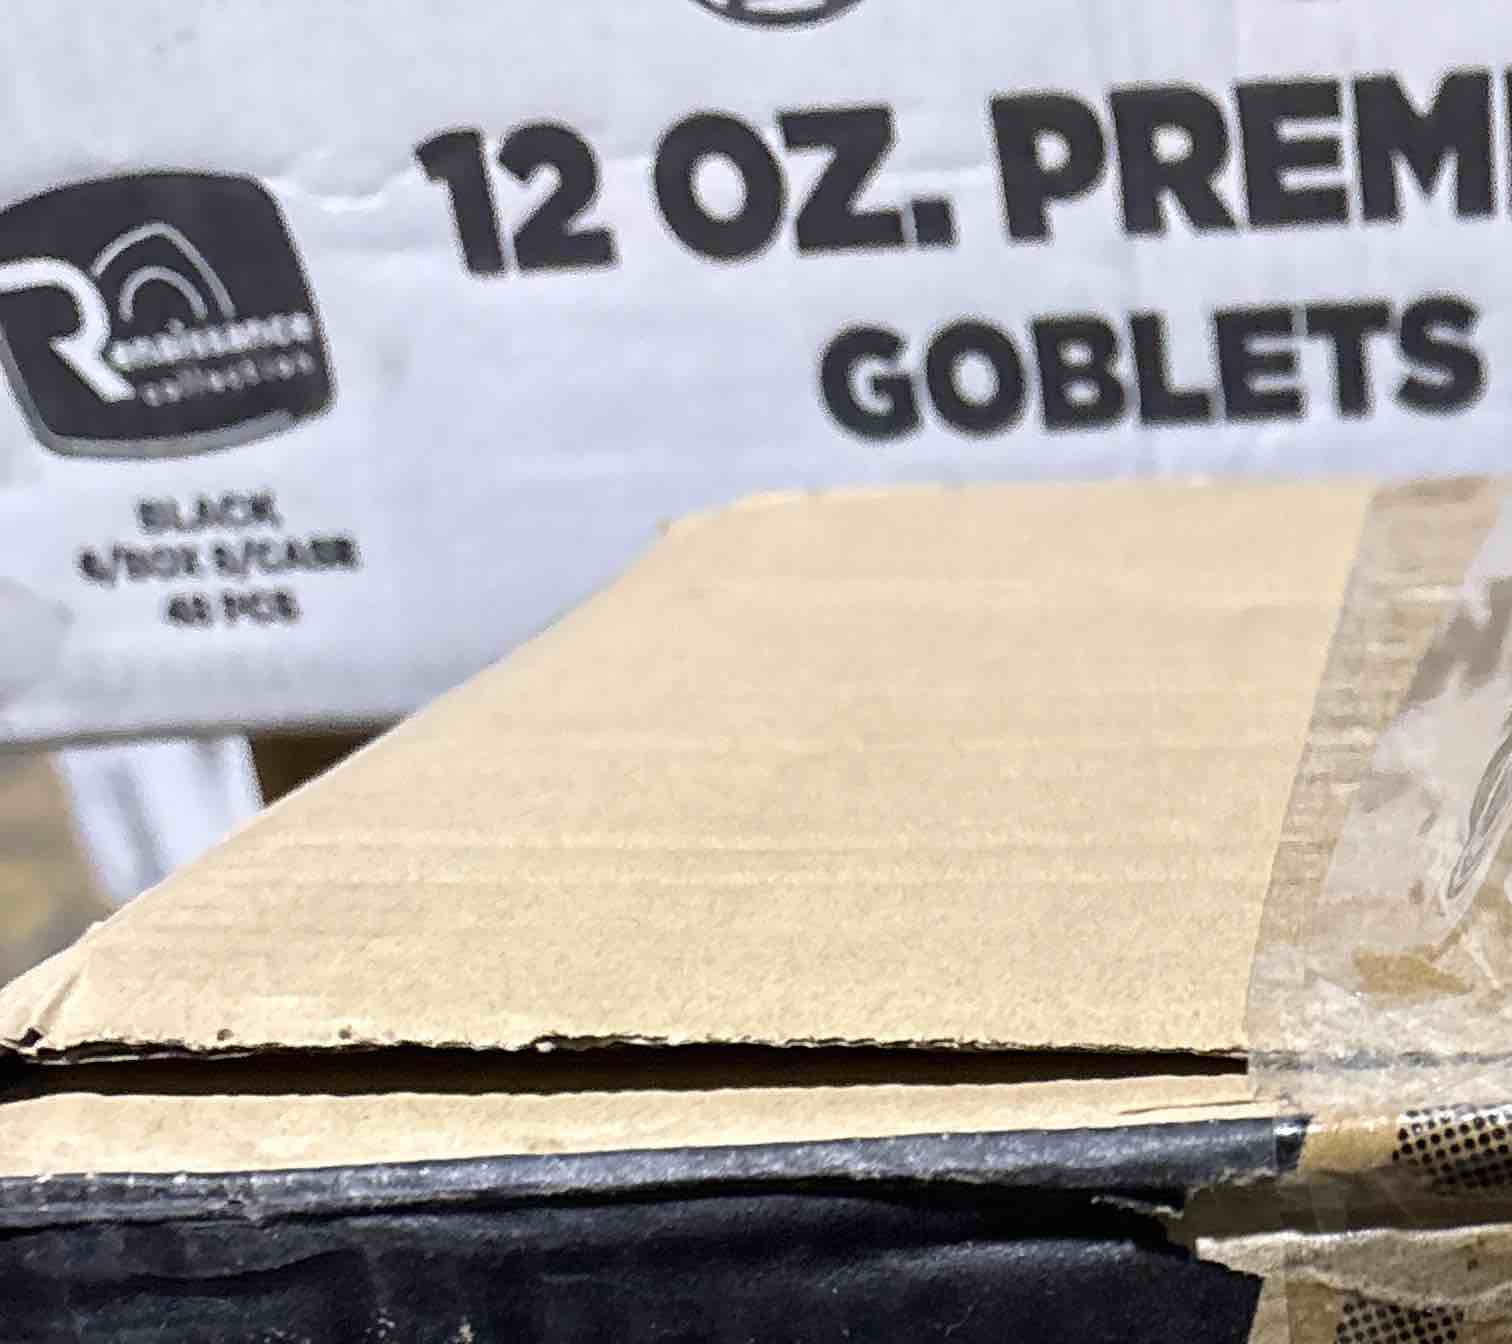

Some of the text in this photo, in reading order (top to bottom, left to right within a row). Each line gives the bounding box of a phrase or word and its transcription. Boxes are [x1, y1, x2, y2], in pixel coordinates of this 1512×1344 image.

[414, 120, 621, 279] 12
[653, 103, 959, 264] OZ.
[820, 293, 1487, 442] GOBLETS
[137, 489, 281, 534] BLACK
